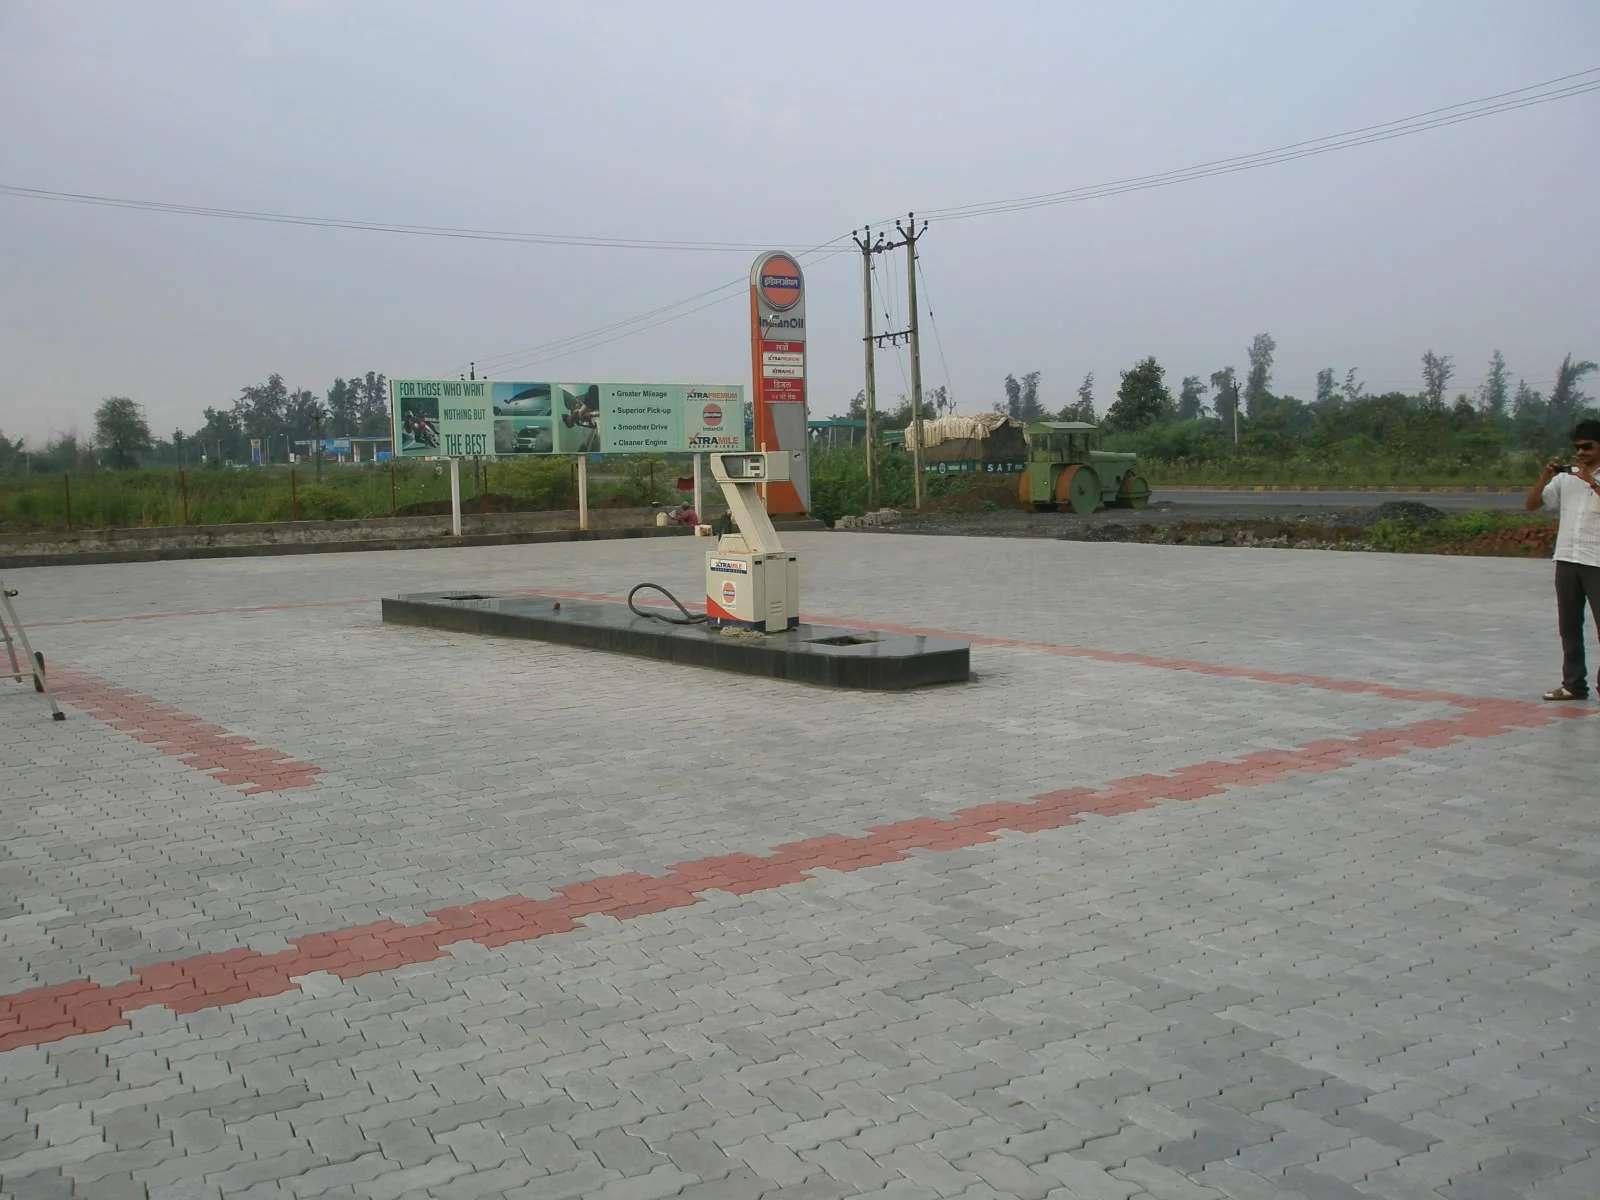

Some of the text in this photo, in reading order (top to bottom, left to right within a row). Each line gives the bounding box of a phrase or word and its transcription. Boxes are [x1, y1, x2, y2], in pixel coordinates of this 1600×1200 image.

[400, 382, 485, 397] FOR THOSE WHO WANT
[643, 390, 667, 399] Mileage
[444, 408, 486, 420] NOTHING BUT
[617, 407, 671, 415] Superior Pick-up
[445, 434, 487, 455] THE BEST
[645, 439, 668, 447] Engine
[688, 432, 740, 445] XTRAMILE
